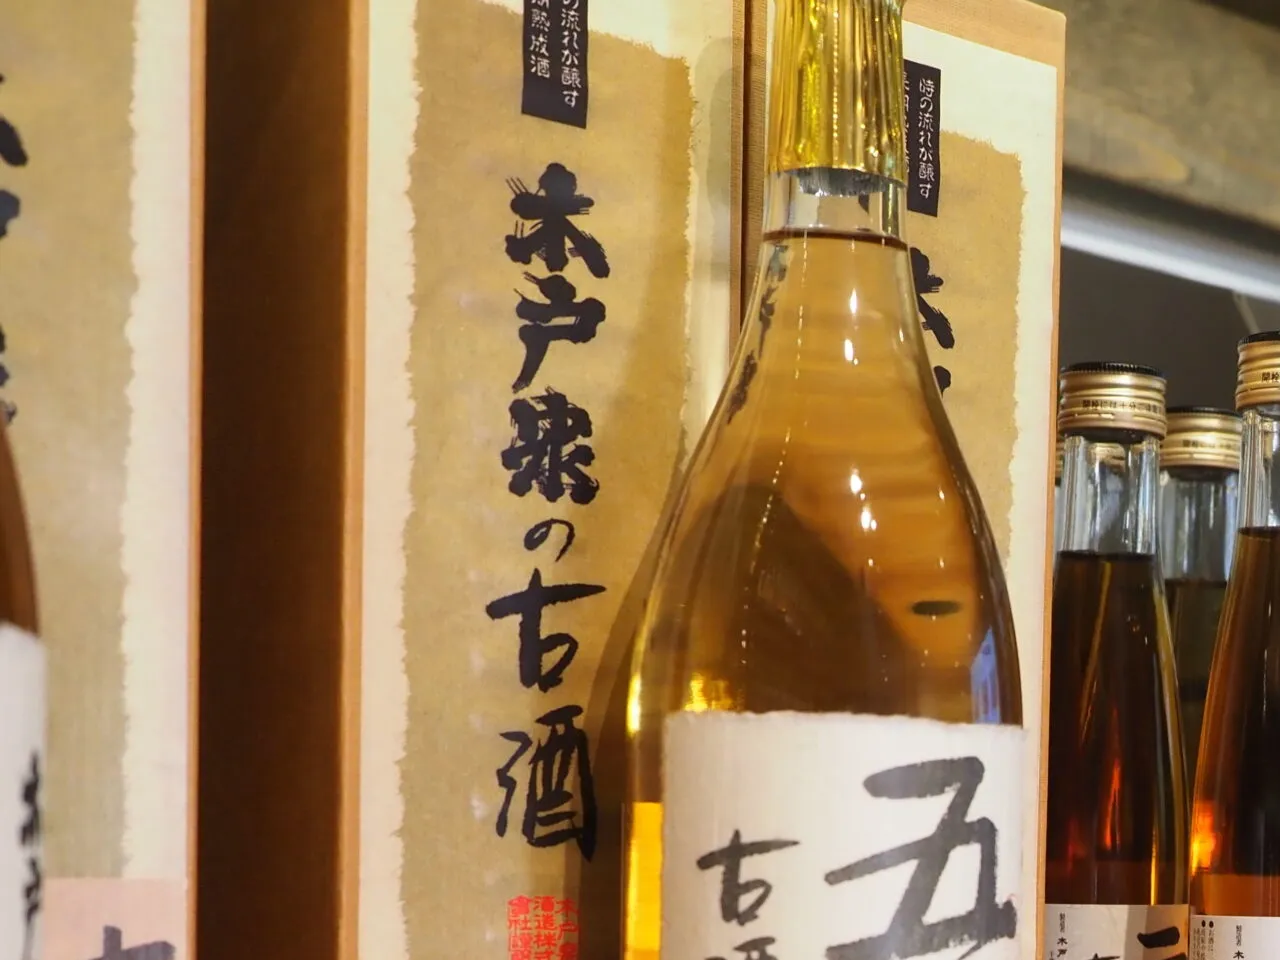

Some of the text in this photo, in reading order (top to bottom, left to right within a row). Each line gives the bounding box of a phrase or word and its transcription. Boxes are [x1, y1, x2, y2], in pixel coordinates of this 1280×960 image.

[918, 78, 935, 199] 時の流れが醸す
